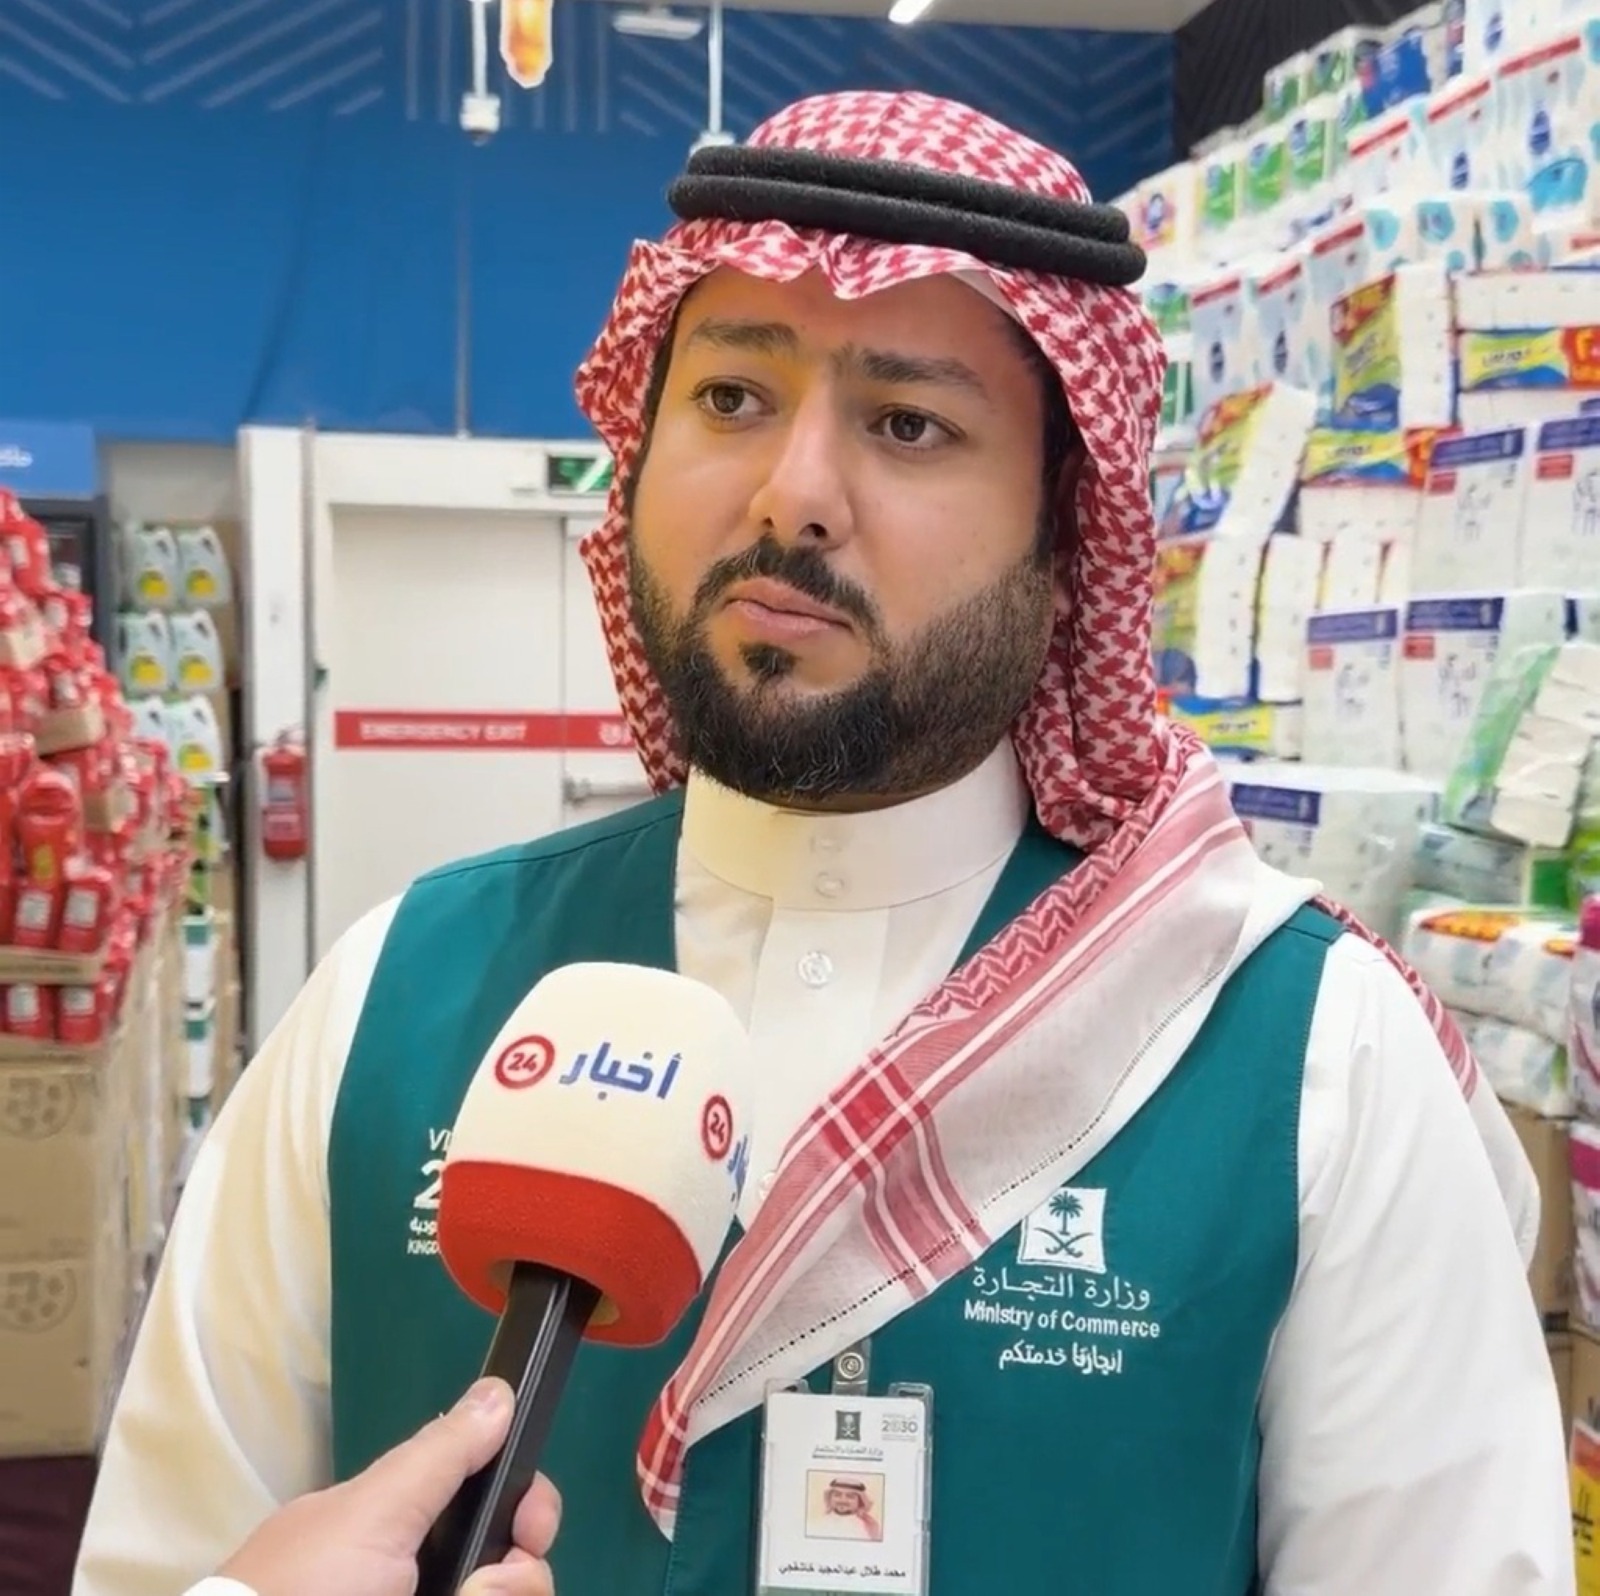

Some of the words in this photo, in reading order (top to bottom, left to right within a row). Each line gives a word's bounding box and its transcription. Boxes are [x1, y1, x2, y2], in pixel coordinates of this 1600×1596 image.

[506, 1051, 538, 1073] 24
[558, 1041, 683, 1101] أخبار
[428, 1127, 452, 1151] VI
[413, 1158, 443, 1209] 2
[972, 1266, 1074, 1301] التجارة
[1084, 1275, 1151, 1311] وزارة
[963, 1299, 1034, 1331] Ministry
[1037, 1309, 1059, 1330] of
[1060, 1310, 1161, 1338] Commerce
[998, 1340, 1067, 1370] خدمتكم
[881, 1420, 919, 1433] 2030
